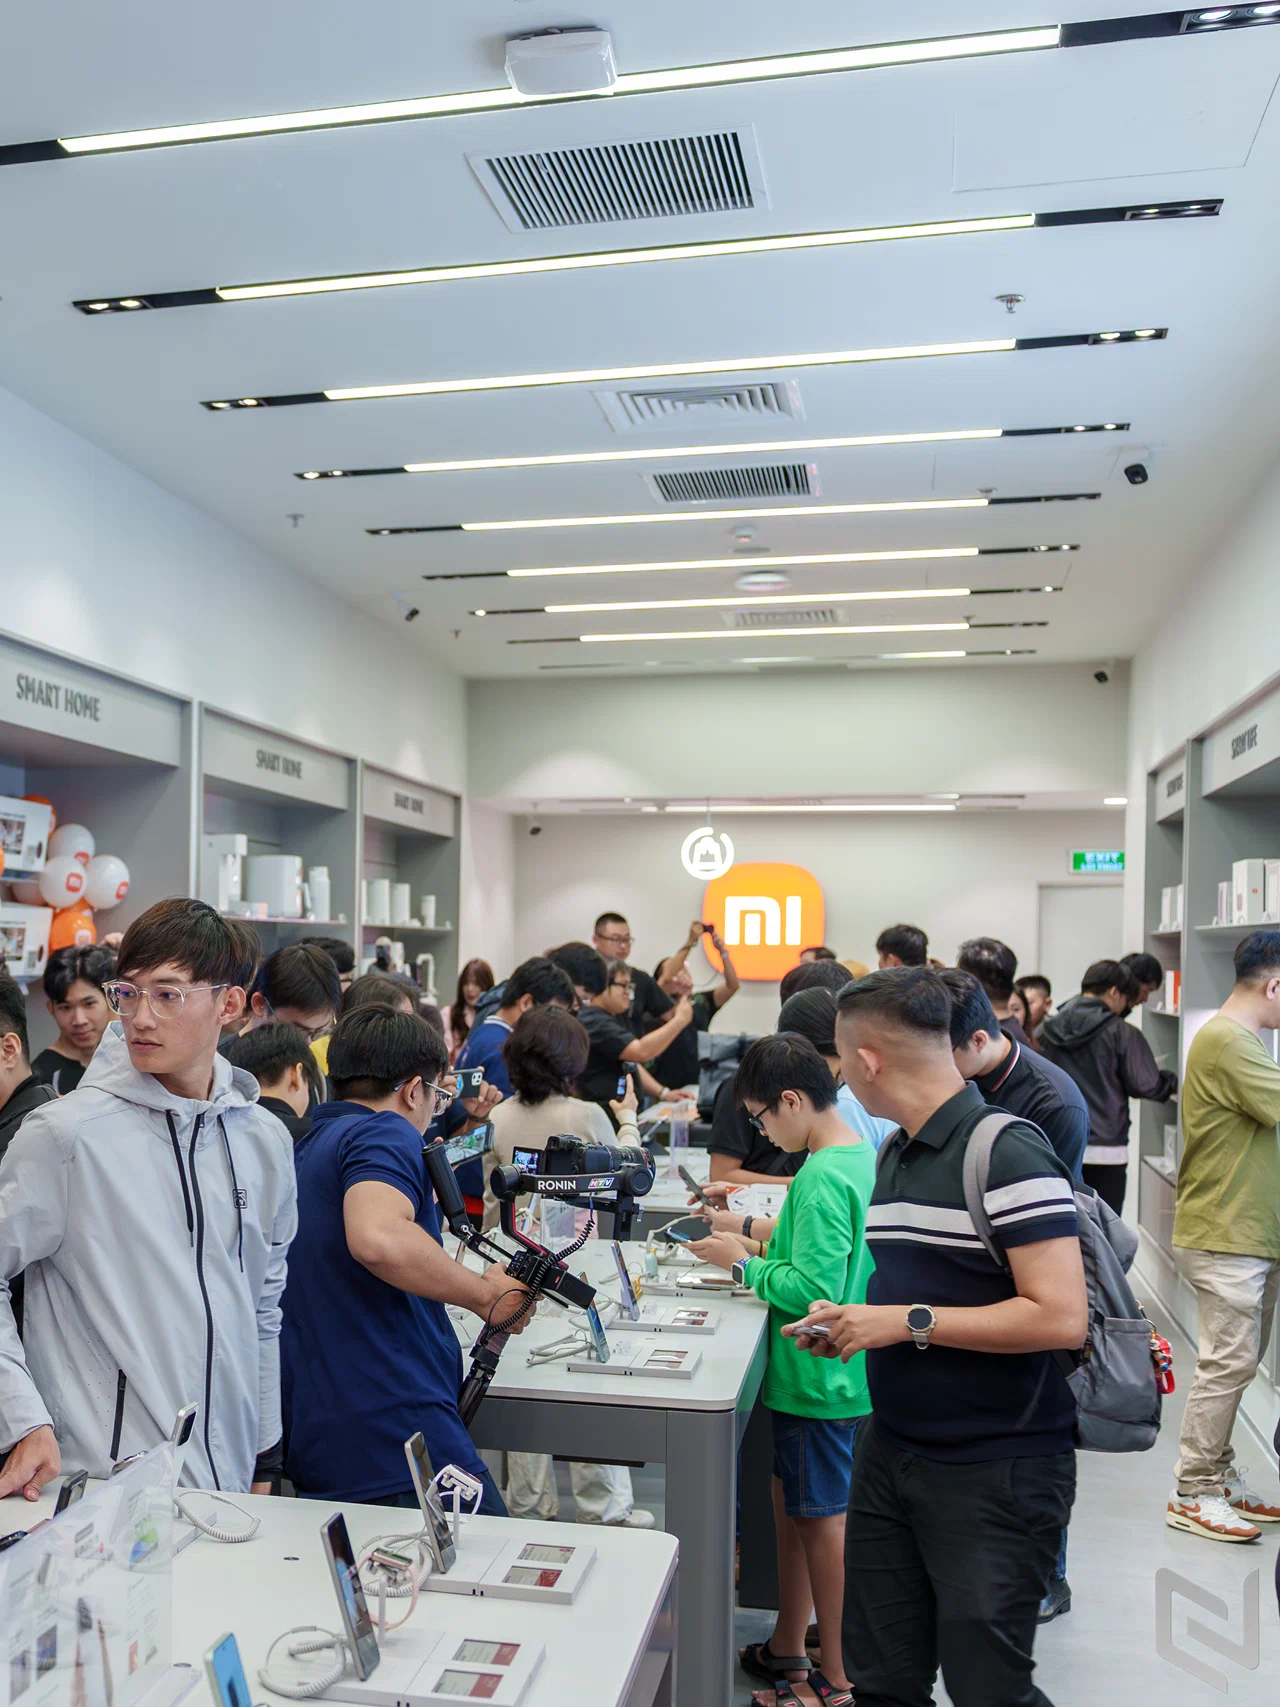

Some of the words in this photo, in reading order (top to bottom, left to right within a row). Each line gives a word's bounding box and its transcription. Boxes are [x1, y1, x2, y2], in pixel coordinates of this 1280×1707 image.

[16, 672, 60, 711] SMART
[64, 688, 101, 722] HOME
[538, 1180, 576, 1190] RONIN
[588, 1177, 614, 1189] HTV
